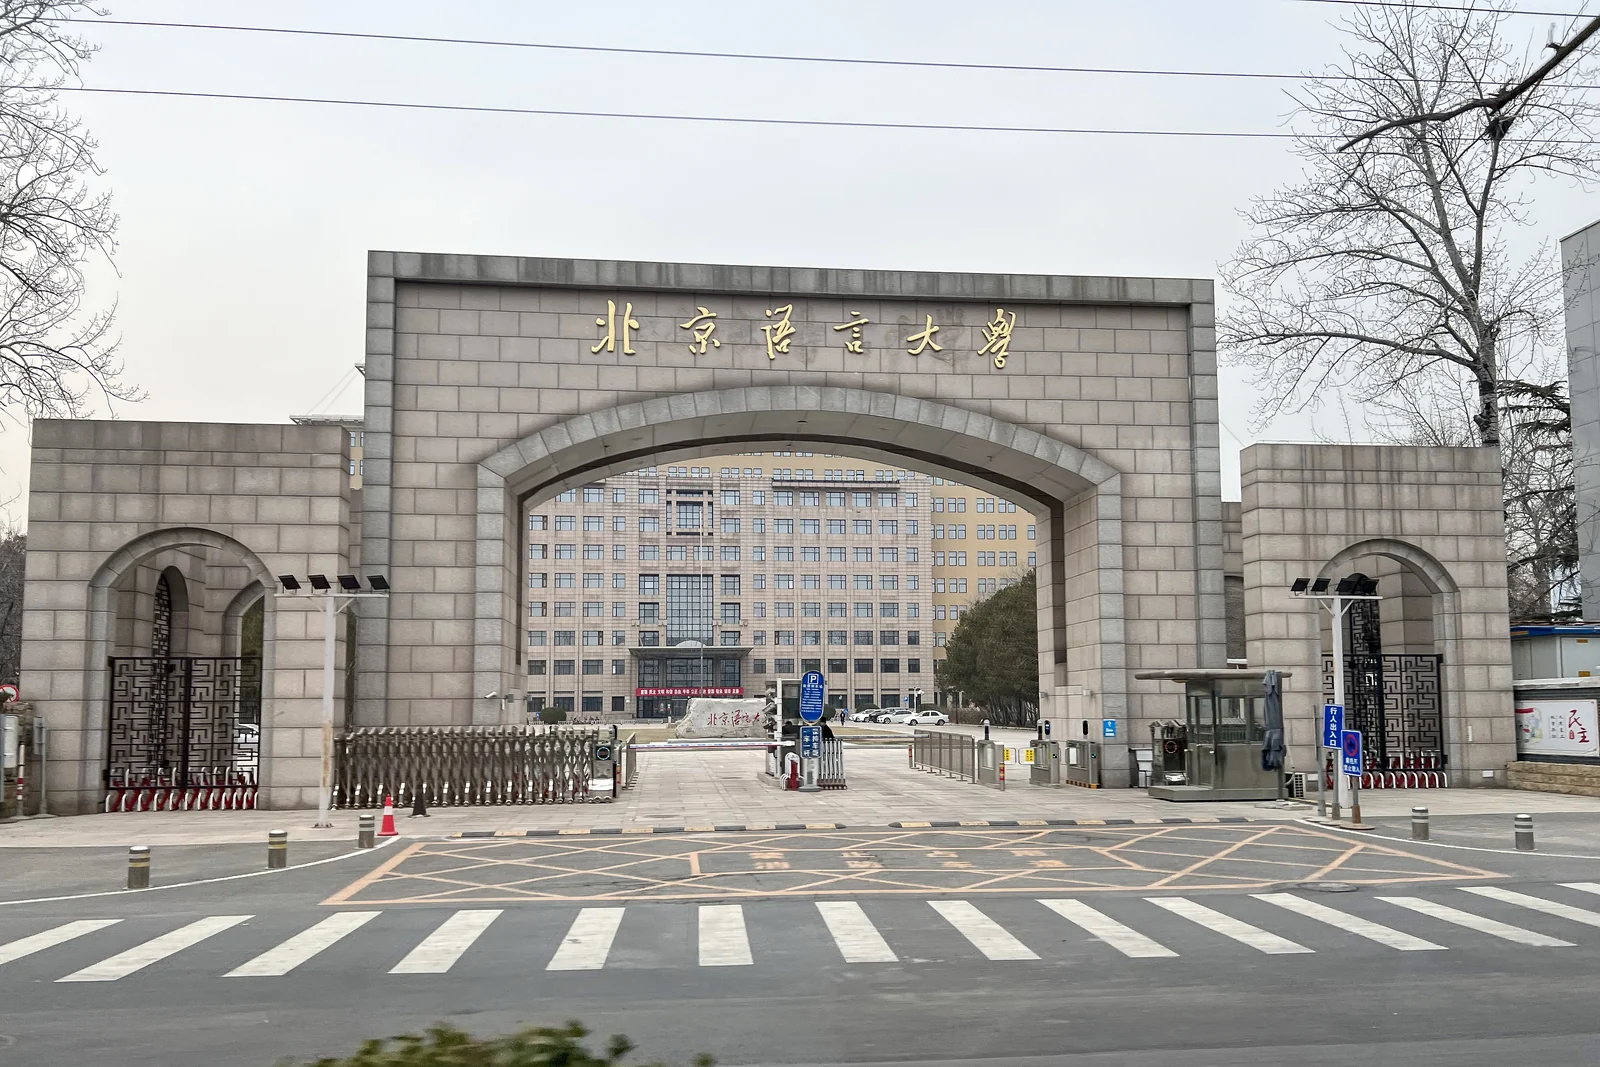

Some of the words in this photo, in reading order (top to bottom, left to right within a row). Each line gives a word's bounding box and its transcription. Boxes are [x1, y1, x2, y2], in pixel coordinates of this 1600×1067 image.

[810, 675, 817, 683] P
[1329, 707, 1338, 747] 行人出入口
[1568, 709, 1590, 743] 民主
